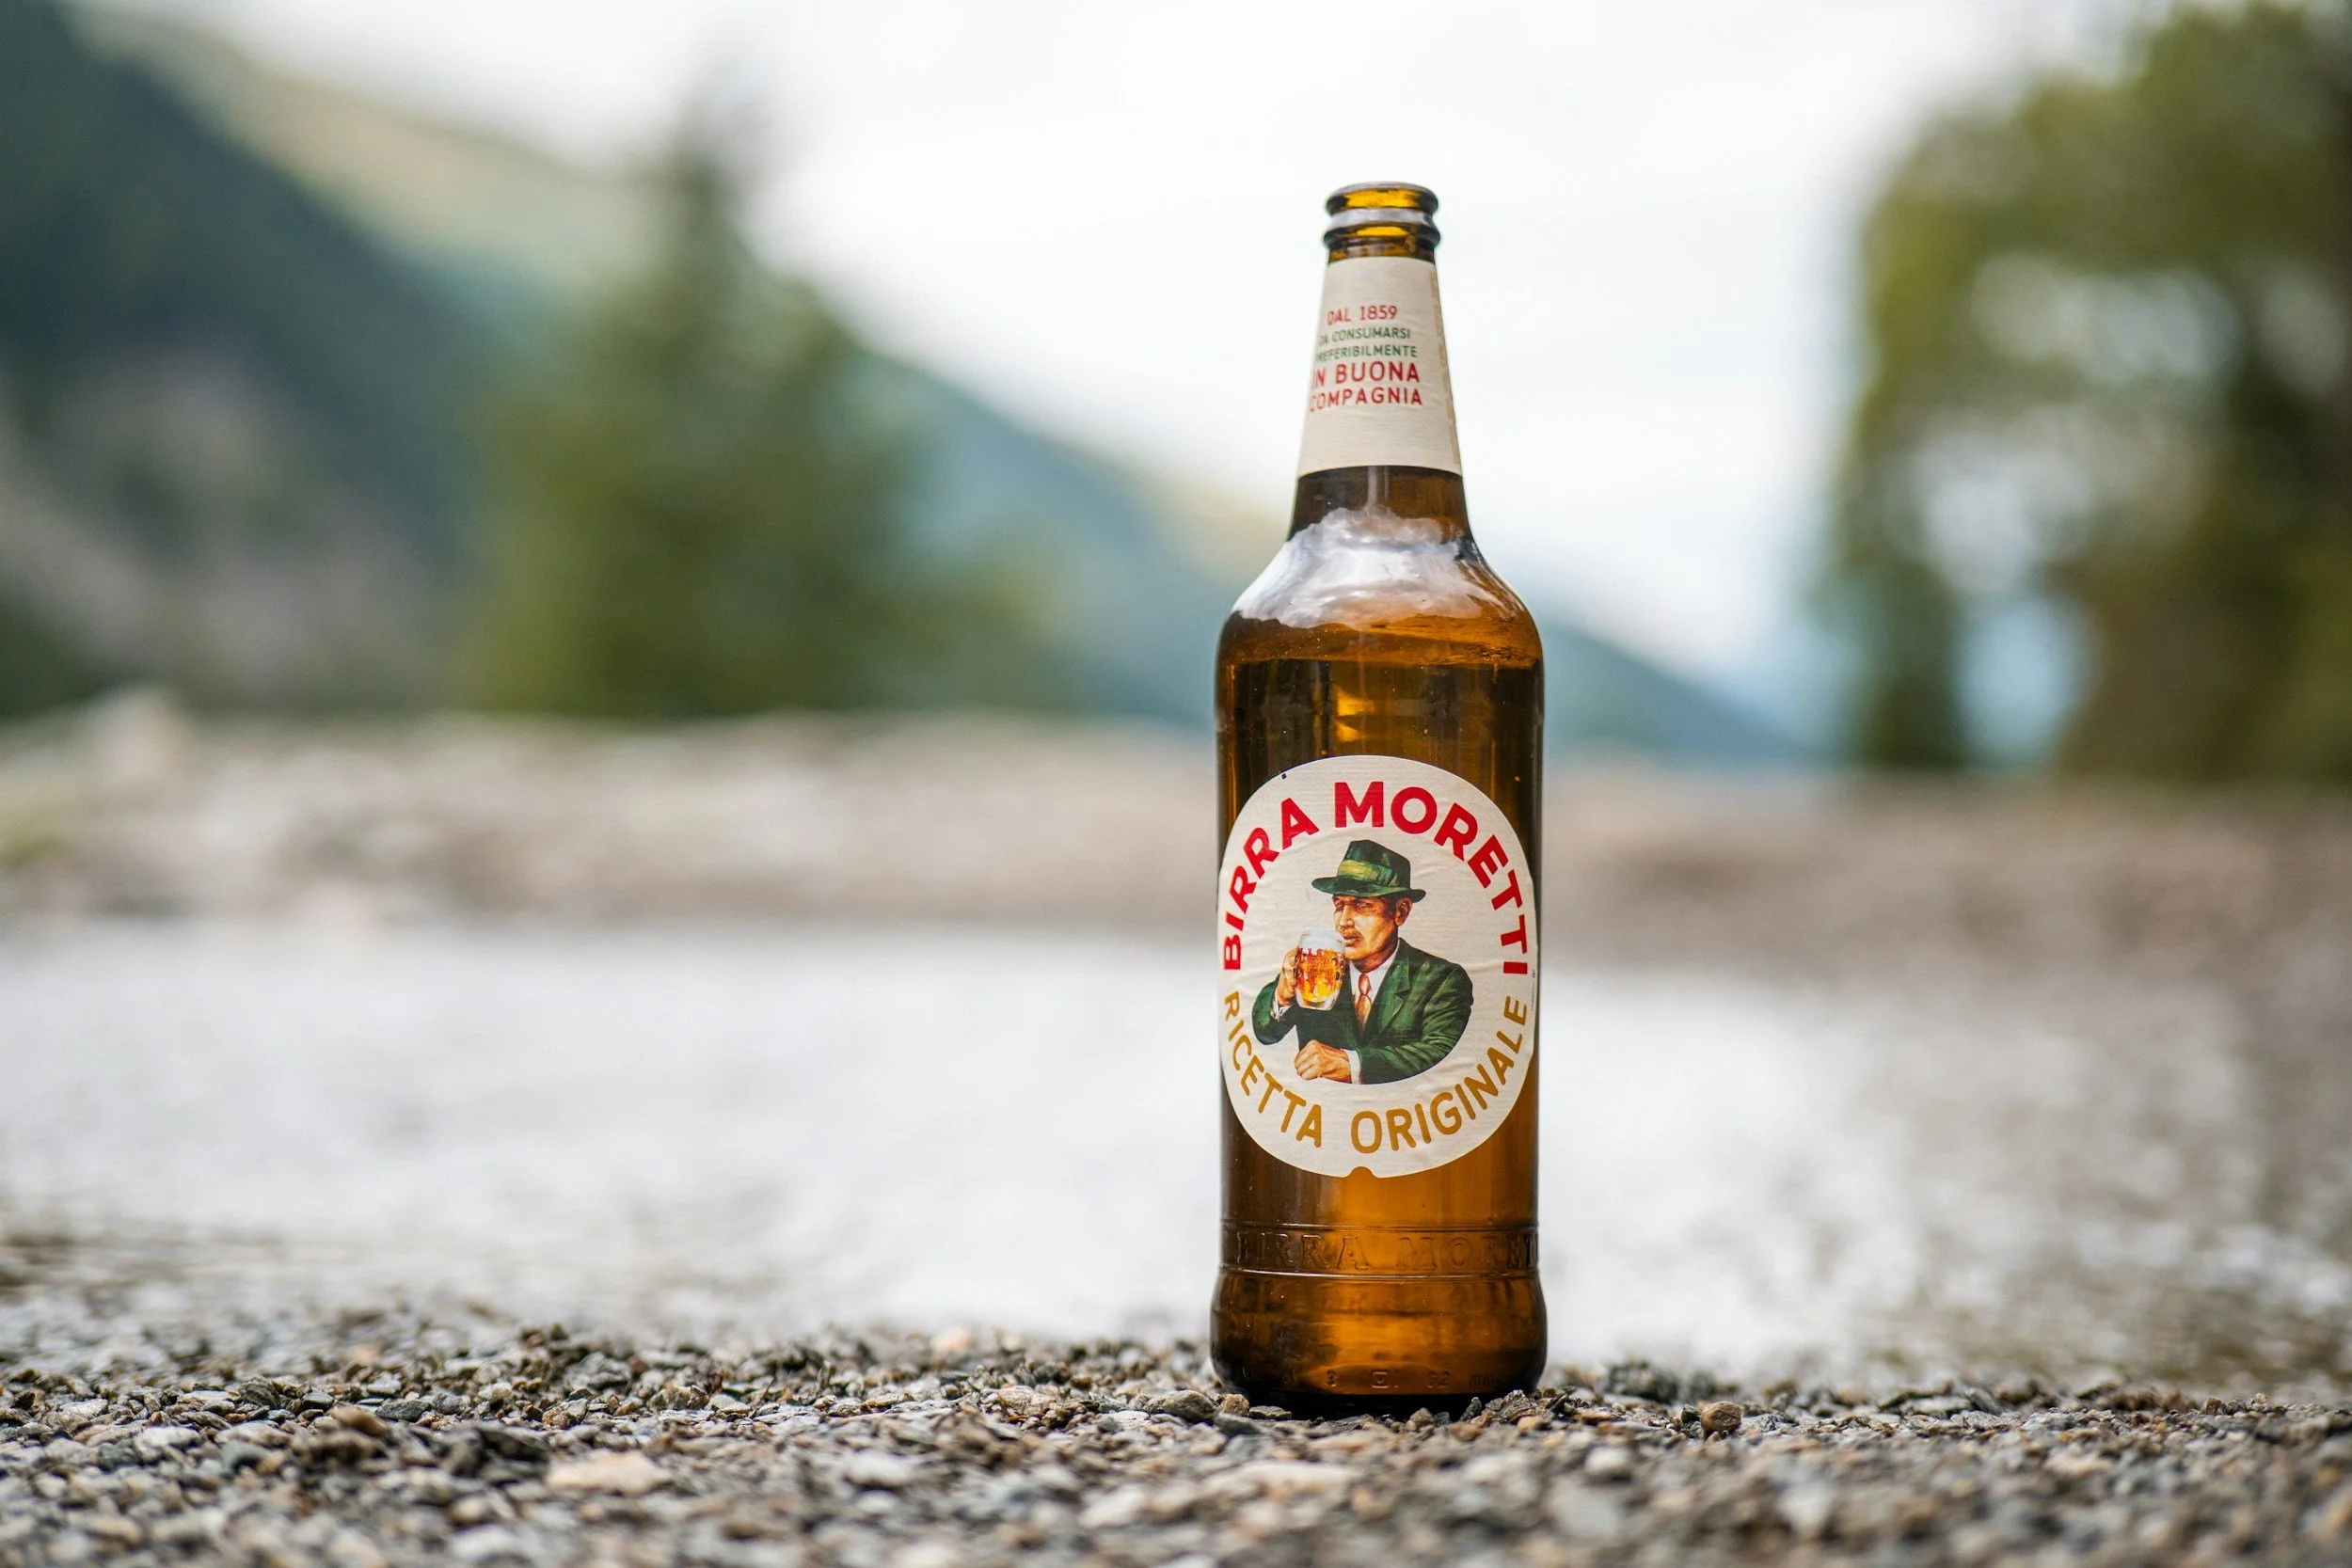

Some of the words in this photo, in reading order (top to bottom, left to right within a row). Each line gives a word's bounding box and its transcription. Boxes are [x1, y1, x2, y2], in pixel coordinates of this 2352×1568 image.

[1327, 308, 1351, 325] DAL
[1359, 305, 1398, 320] 1859
[1332, 327, 1410, 341] CONSUMARSI
[1311, 366, 1327, 389] IN
[1334, 360, 1421, 385] BUONA
[1309, 386, 1423, 413] COMPAGNIA
[1224, 798, 1320, 971] BIRRA
[1334, 781, 1529, 975] MORETTI
[1224, 990, 1323, 1148] RICETTA
[1350, 994, 1528, 1154] ORIGINALE
